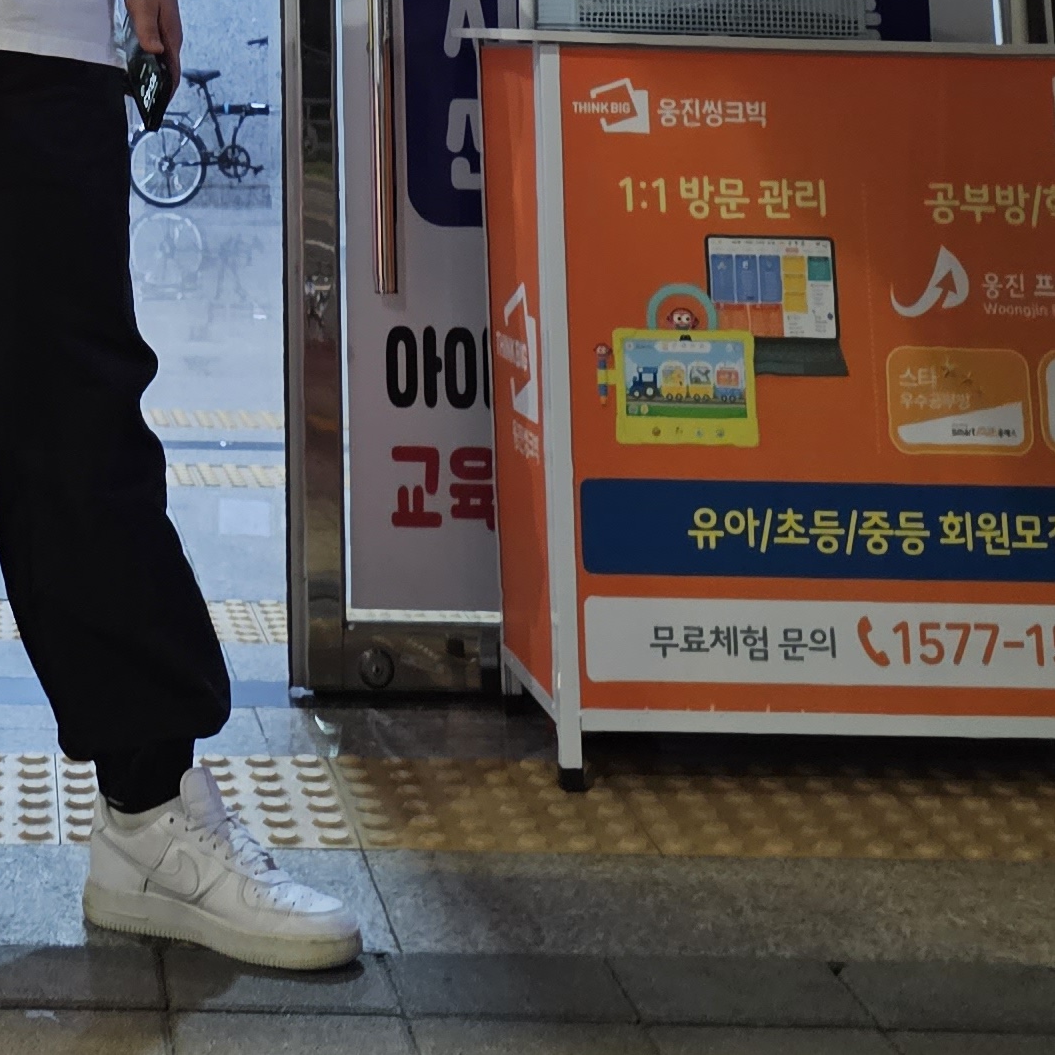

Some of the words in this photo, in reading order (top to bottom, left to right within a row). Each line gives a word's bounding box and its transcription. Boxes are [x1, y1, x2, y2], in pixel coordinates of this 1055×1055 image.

[572, 100, 610, 115] THINK
[611, 101, 632, 115] BIG
[657, 98, 767, 128] 웅진씽크빅
[619, 176, 668, 212] 1:1
[679, 177, 750, 220] 방문
[758, 177, 828, 220] 관리
[982, 272, 1025, 300] 웅진
[984, 302, 1048, 320] Woongjin
[899, 366, 938, 389] 스타
[687, 506, 931, 558] 유아/초등/중등
[939, 510, 1055, 556] 회원모
[650, 625, 769, 662] 무료체험
[779, 625, 838, 662] 문의
[893, 620, 1055, 668] 1577-1
